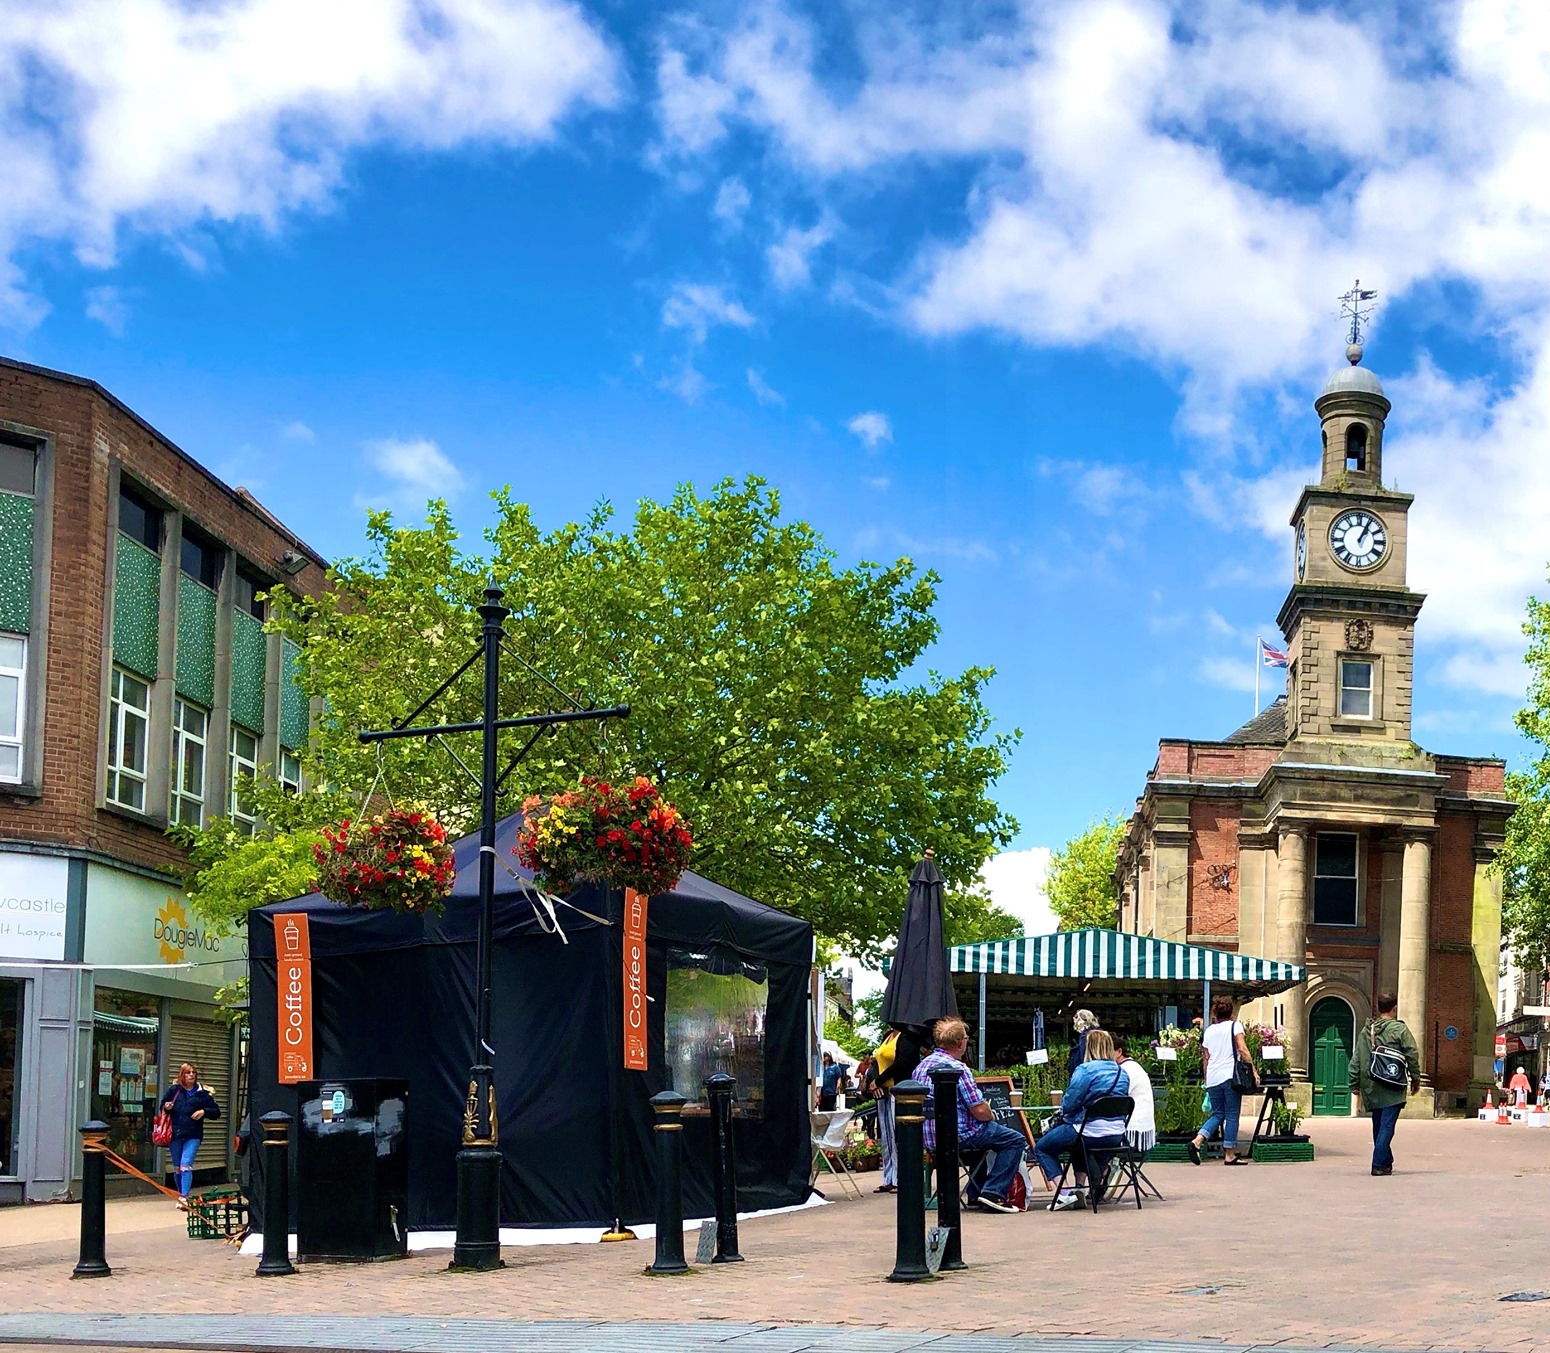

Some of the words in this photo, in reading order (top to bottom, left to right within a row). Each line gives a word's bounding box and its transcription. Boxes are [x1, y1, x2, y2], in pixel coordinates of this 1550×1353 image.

[0, 898, 65, 913] castle
[17, 923, 63, 941] hospice
[286, 967, 303, 1045] Coffee
[629, 946, 641, 1028] Coffee
